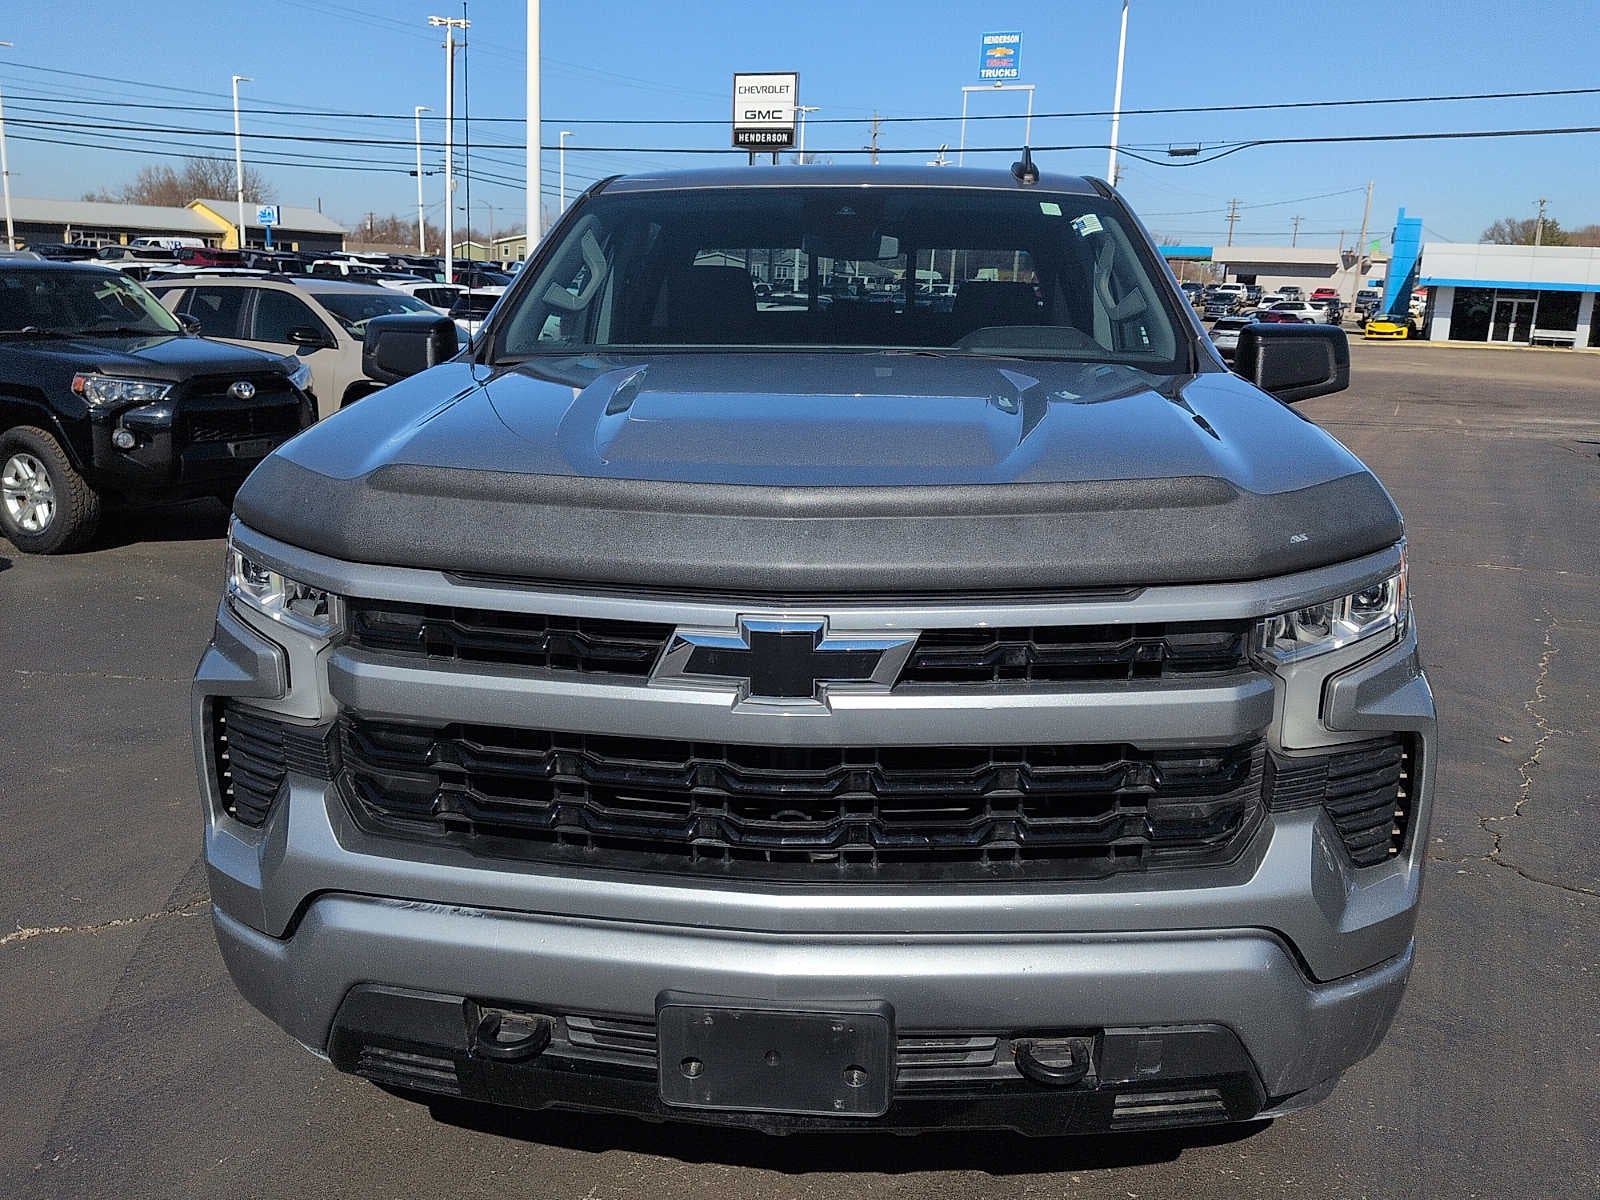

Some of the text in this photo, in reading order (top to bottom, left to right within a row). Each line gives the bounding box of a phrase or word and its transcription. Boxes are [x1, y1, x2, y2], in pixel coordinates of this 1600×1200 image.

[981, 68, 1017, 78] TRUCKS
[738, 85, 790, 94] CHEVROLET
[744, 110, 783, 120] GMC
[738, 133, 788, 143] HENDERSON
